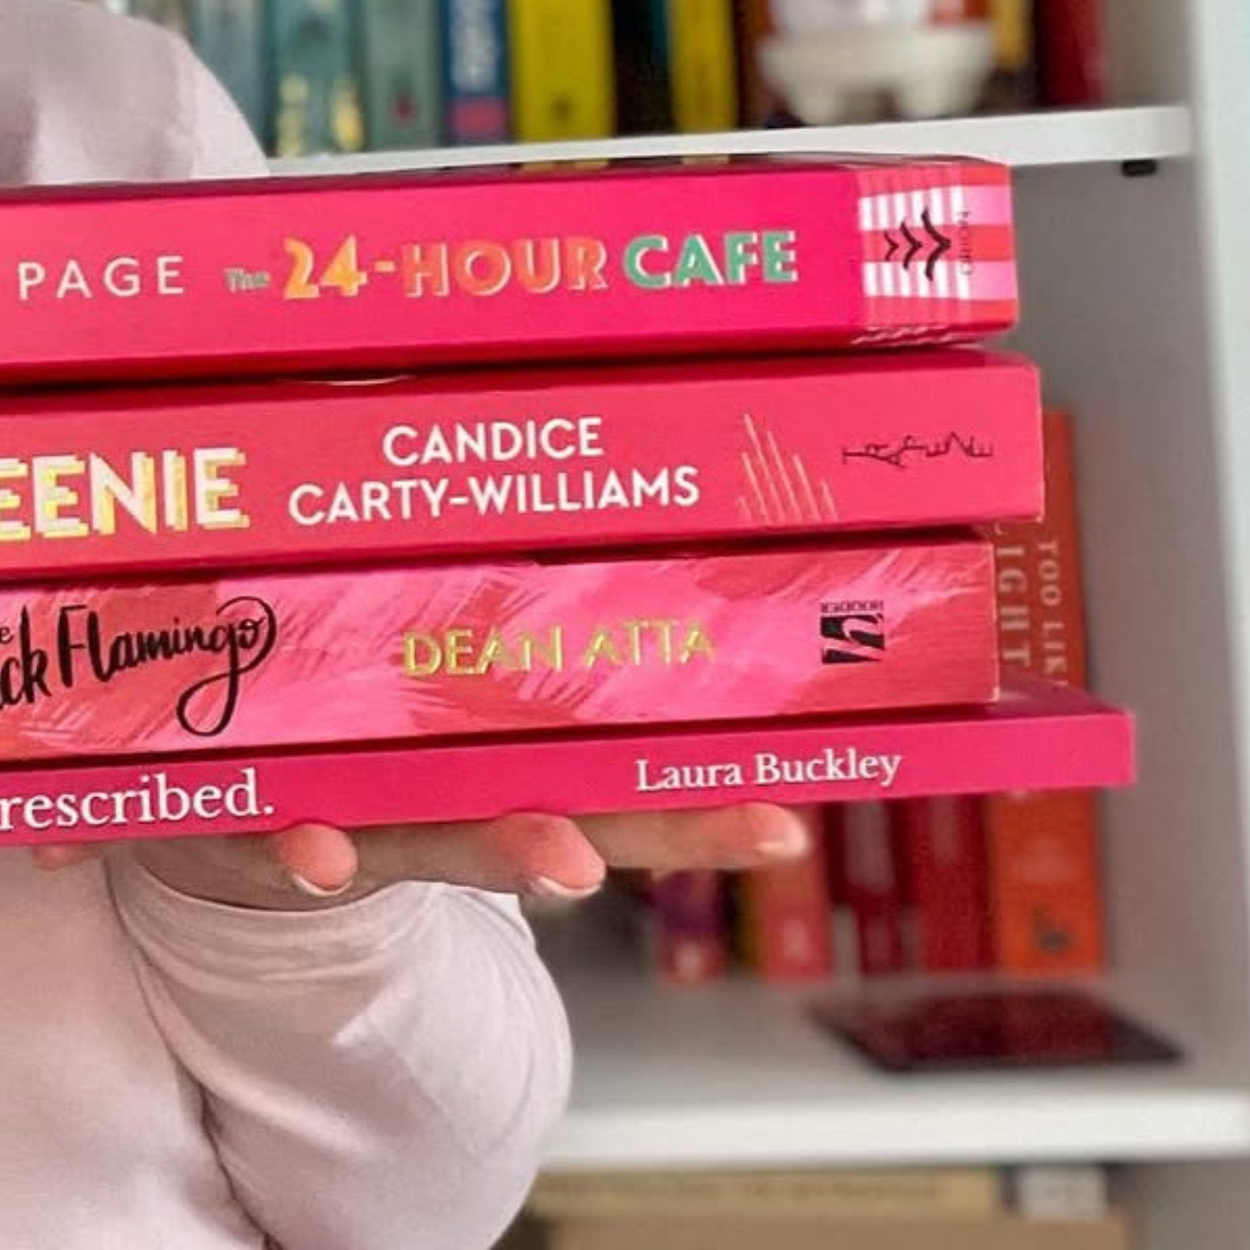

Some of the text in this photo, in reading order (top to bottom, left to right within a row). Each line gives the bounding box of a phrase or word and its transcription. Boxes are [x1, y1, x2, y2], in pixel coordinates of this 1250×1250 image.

[19, 254, 186, 300] PAGE
[224, 266, 271, 293] The
[283, 234, 608, 300] 24-HOUR
[622, 230, 799, 290] CAFE
[383, 416, 605, 468] CANDICE
[288, 464, 702, 526] CARTY-WILLIAMS
[1038, 540, 1070, 687] TOO LIK
[54, 595, 277, 738] Flamingo
[402, 617, 717, 678] DEAN ATTA
[634, 747, 904, 794] Laura Buckley
